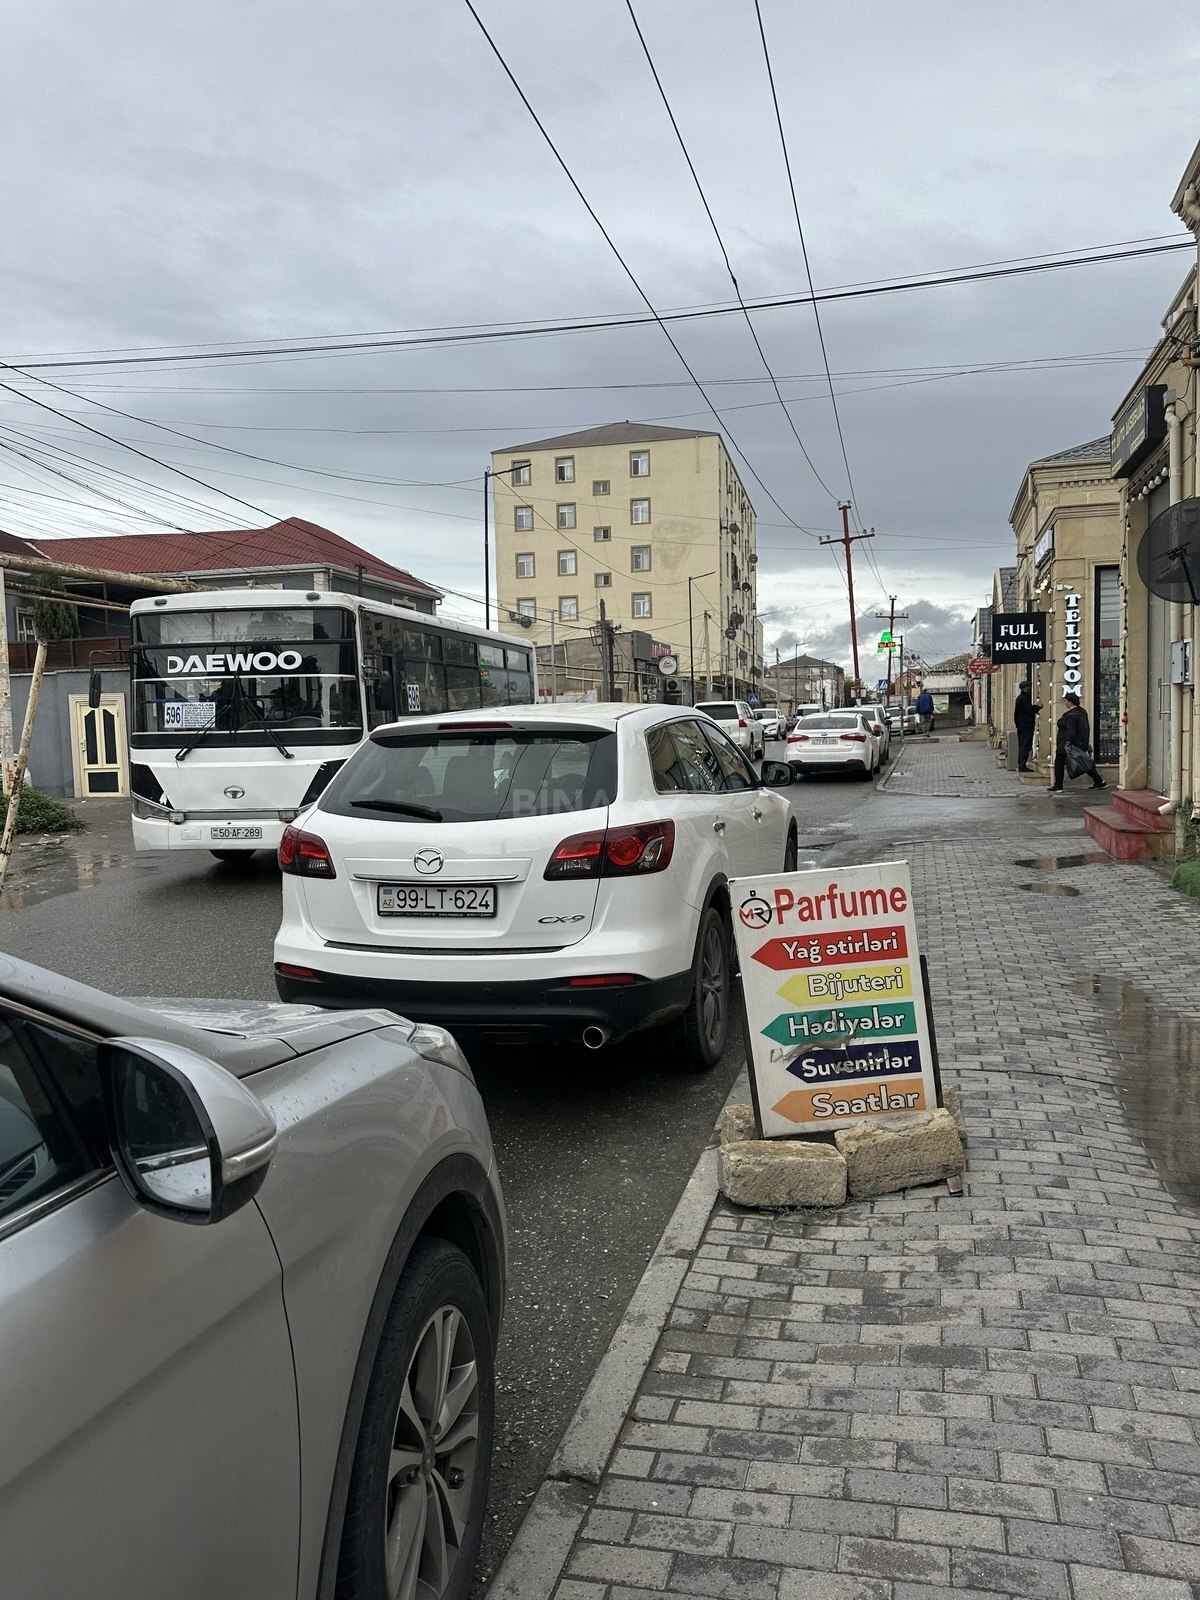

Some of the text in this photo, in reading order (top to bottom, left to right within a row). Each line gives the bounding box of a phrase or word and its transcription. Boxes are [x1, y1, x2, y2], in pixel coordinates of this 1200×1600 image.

[1000, 623, 1039, 637] FULL
[995, 640, 1043, 651] PARFUM
[1062, 593, 1083, 699] TELECOM
[167, 650, 303, 674] DAEWOO
[166, 706, 181, 724] 596
[396, 888, 490, 909] 99-LT-624
[774, 884, 908, 925] Parfume
[538, 914, 585, 924] CX-9
[782, 931, 898, 964] Yağ ətirləri
[807, 966, 904, 1001] Bijuteri
[788, 1006, 905, 1037] Hədiyələr
[801, 1048, 913, 1078] Suvenirlər
[811, 1084, 920, 1118] Saatlar
